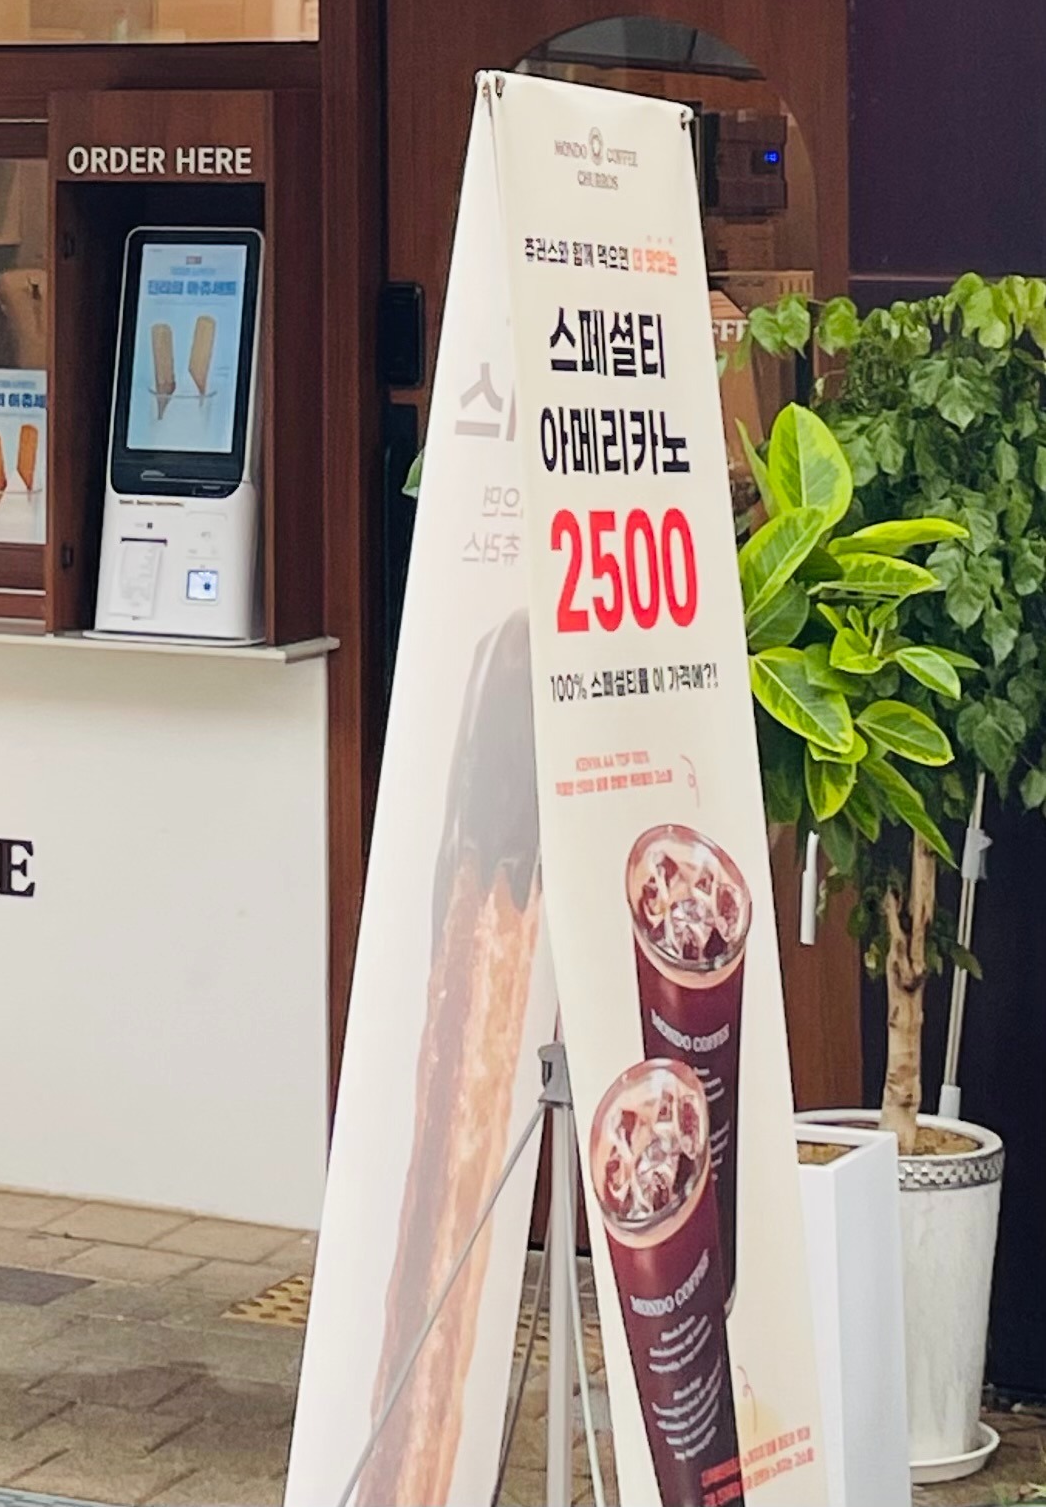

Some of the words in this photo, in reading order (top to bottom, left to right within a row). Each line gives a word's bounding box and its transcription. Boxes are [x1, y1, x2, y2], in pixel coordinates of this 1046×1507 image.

[67, 146, 166, 175] ORDER
[175, 147, 253, 175] HERE
[549, 306, 666, 379] 스페셜티
[540, 406, 691, 476] 아메리카노
[550, 507, 699, 634] 2500
[550, 672, 587, 703] 100%
